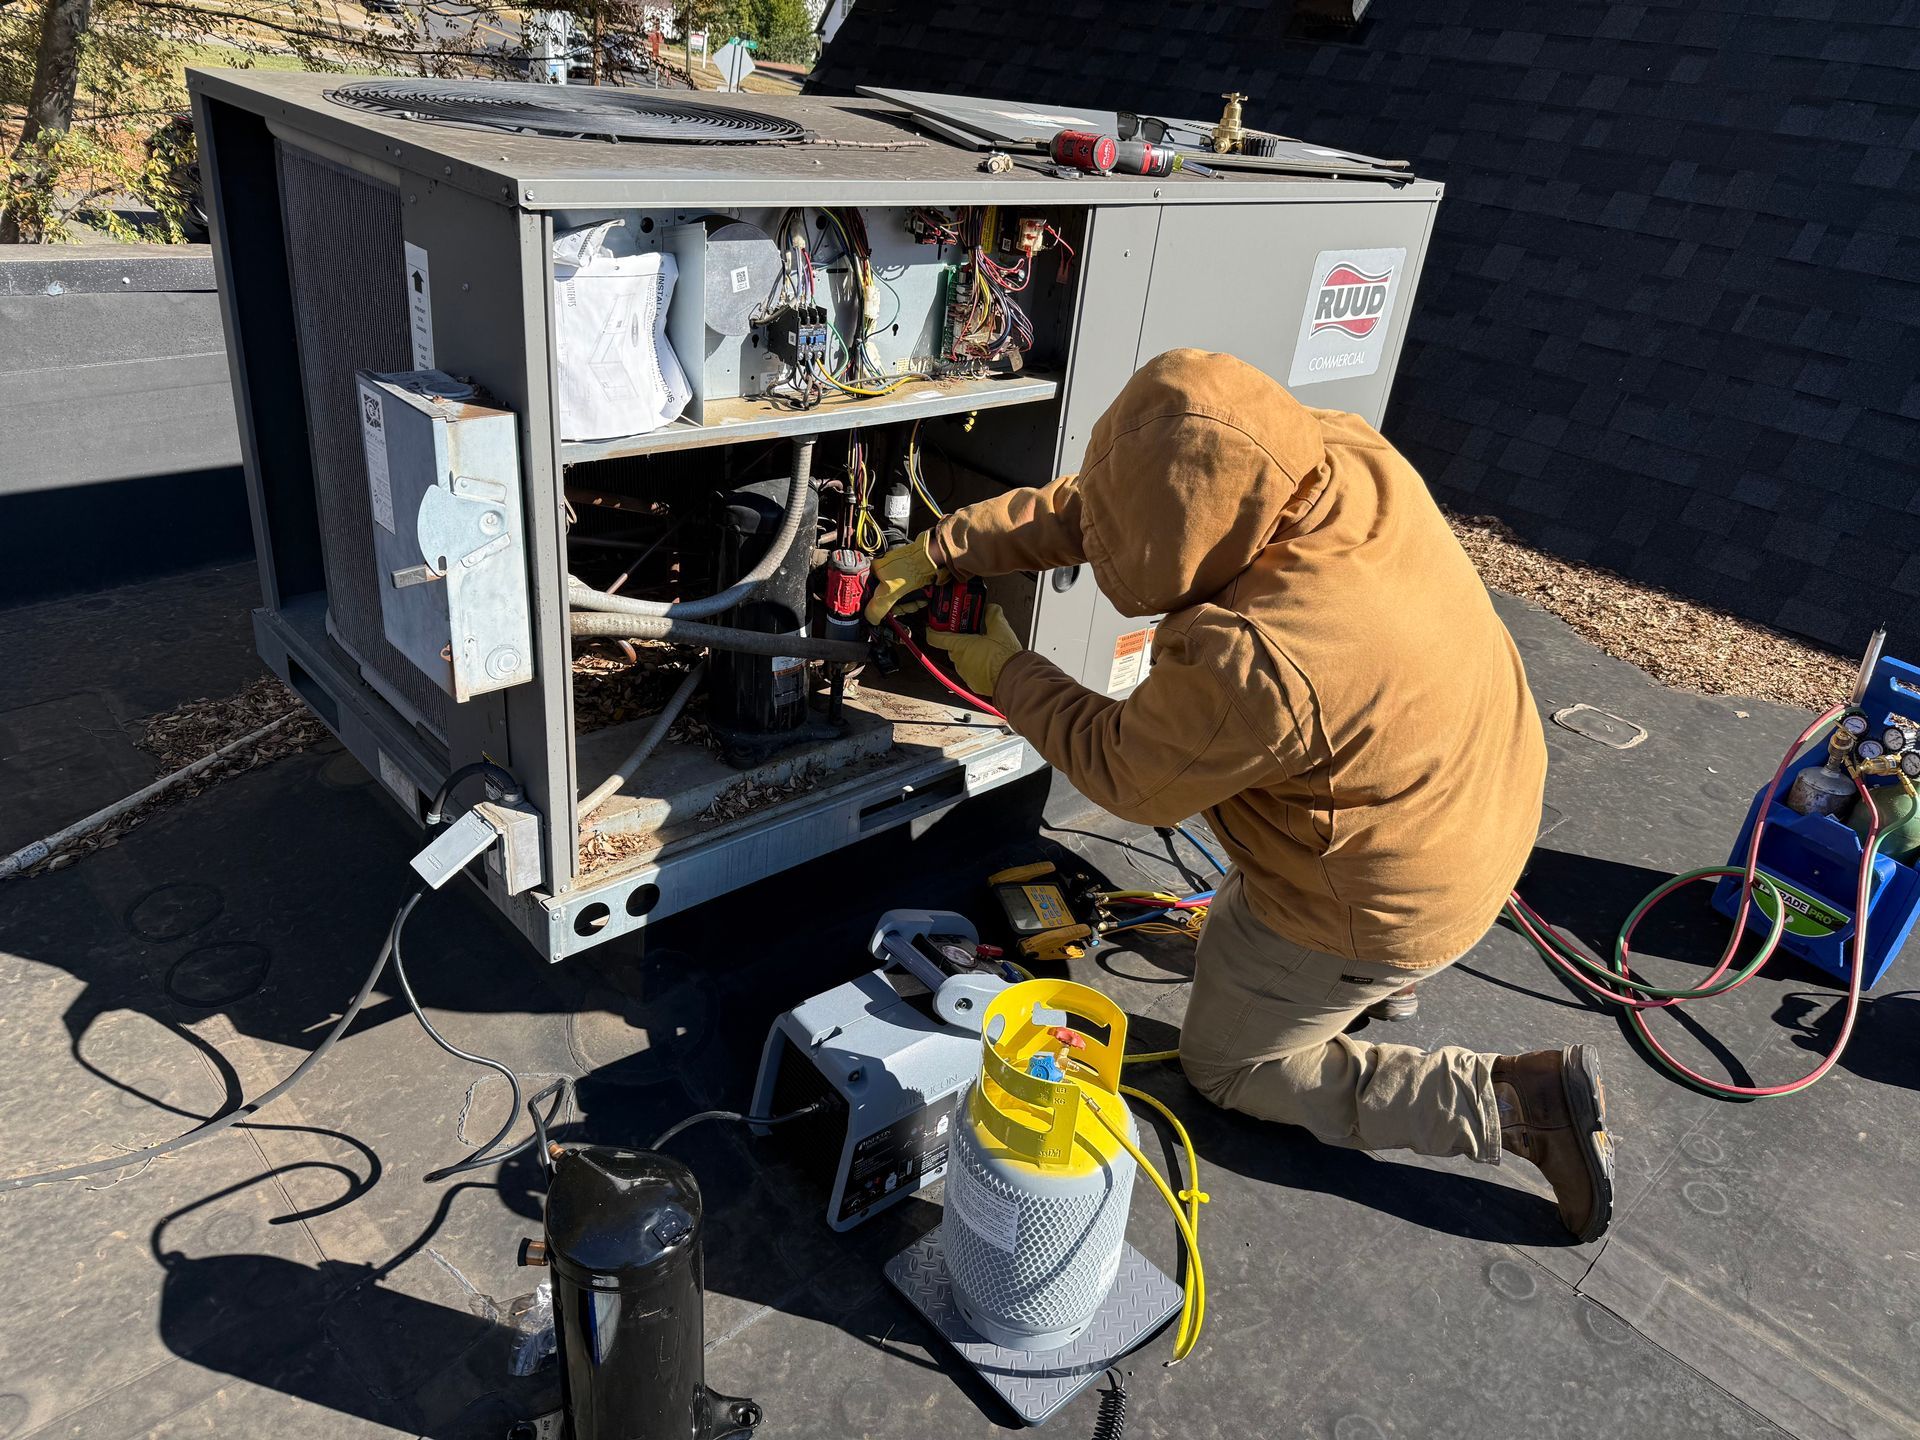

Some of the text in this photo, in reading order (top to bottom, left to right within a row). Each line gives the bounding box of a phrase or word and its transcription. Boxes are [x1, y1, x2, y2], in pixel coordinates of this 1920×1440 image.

[1314, 285, 1387, 320] RUUD
[1308, 352, 1365, 372] COMMERCIAL
[1779, 890, 1832, 925] RADEPRO
